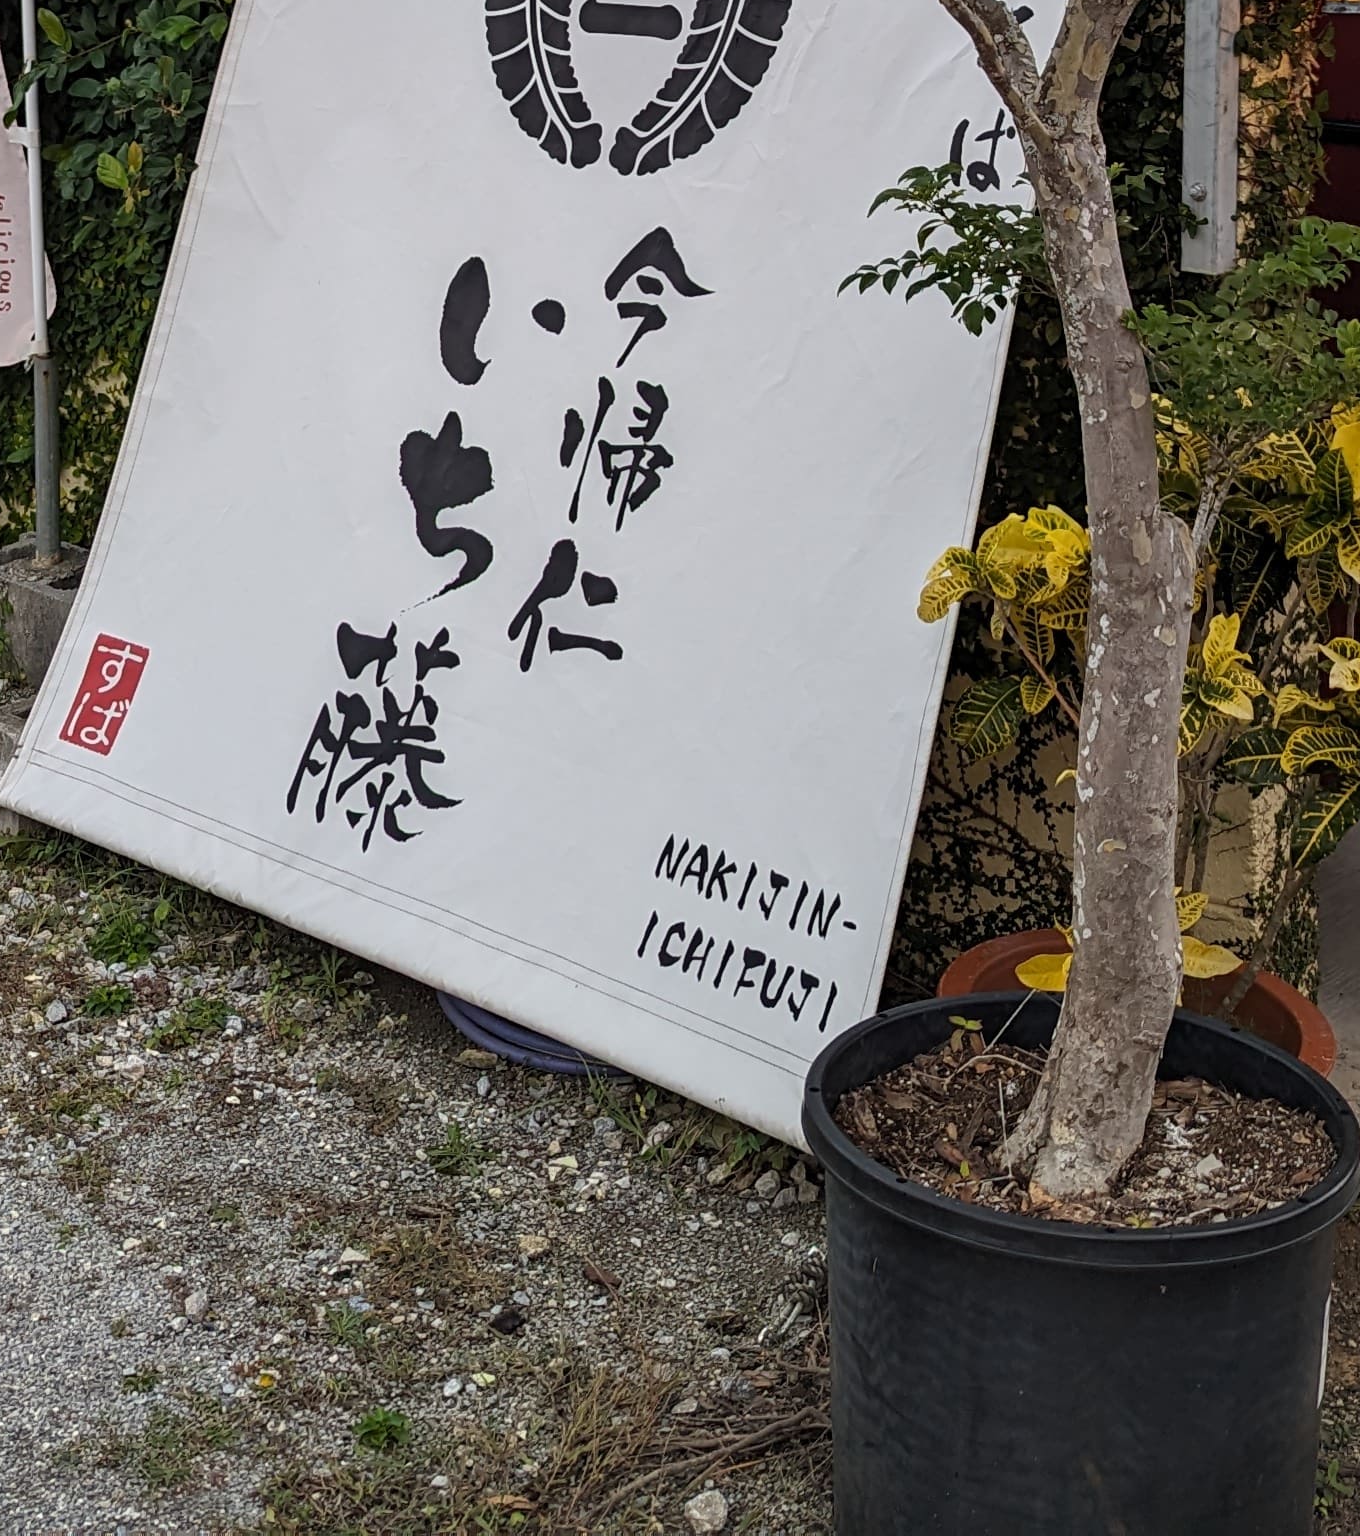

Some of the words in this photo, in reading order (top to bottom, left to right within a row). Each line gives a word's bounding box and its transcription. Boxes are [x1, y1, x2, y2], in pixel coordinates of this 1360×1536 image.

[507, 225, 715, 674] 今帰仁
[67, 644, 144, 747] すば
[654, 832, 858, 941] NAKIJIN-
[636, 909, 838, 1034] ICHIFUJI
